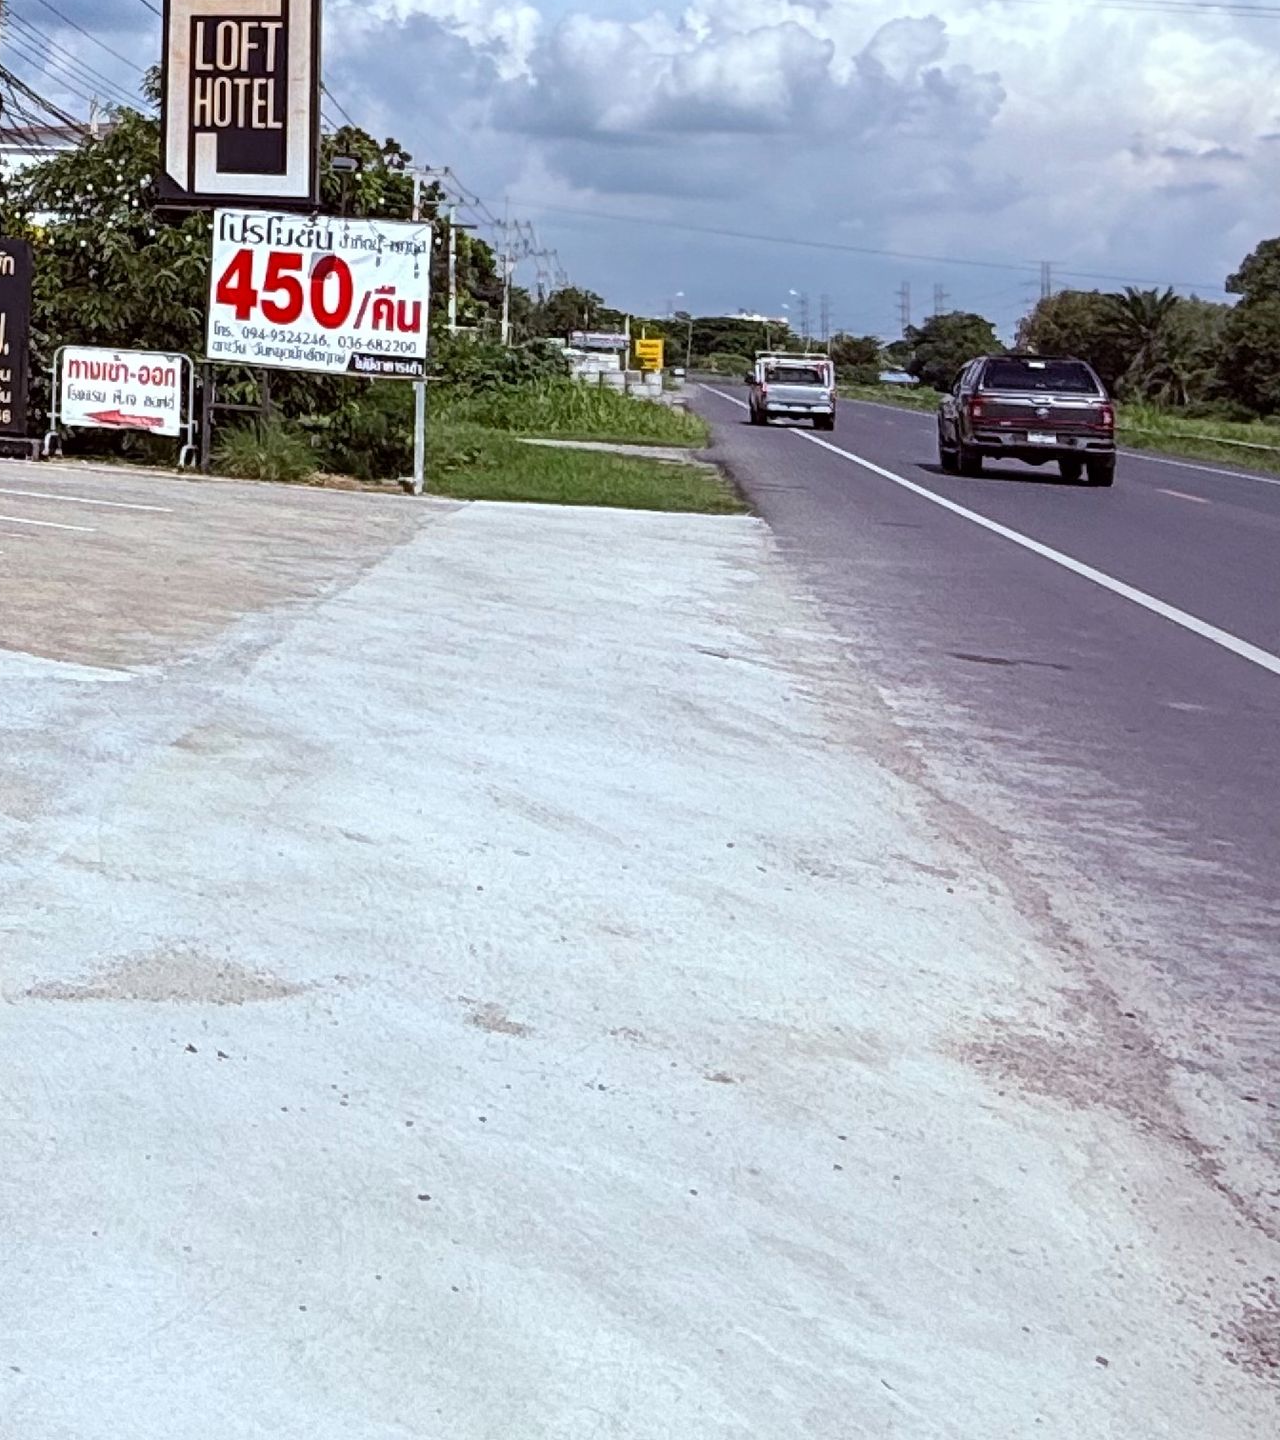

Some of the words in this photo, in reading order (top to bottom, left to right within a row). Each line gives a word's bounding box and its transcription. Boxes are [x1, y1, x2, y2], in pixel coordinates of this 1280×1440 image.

[195, 20, 283, 72] LOFT
[194, 77, 283, 129] HOTEL
[216, 248, 354, 330] 450
[67, 355, 176, 388] ทางเข้า-ออก
